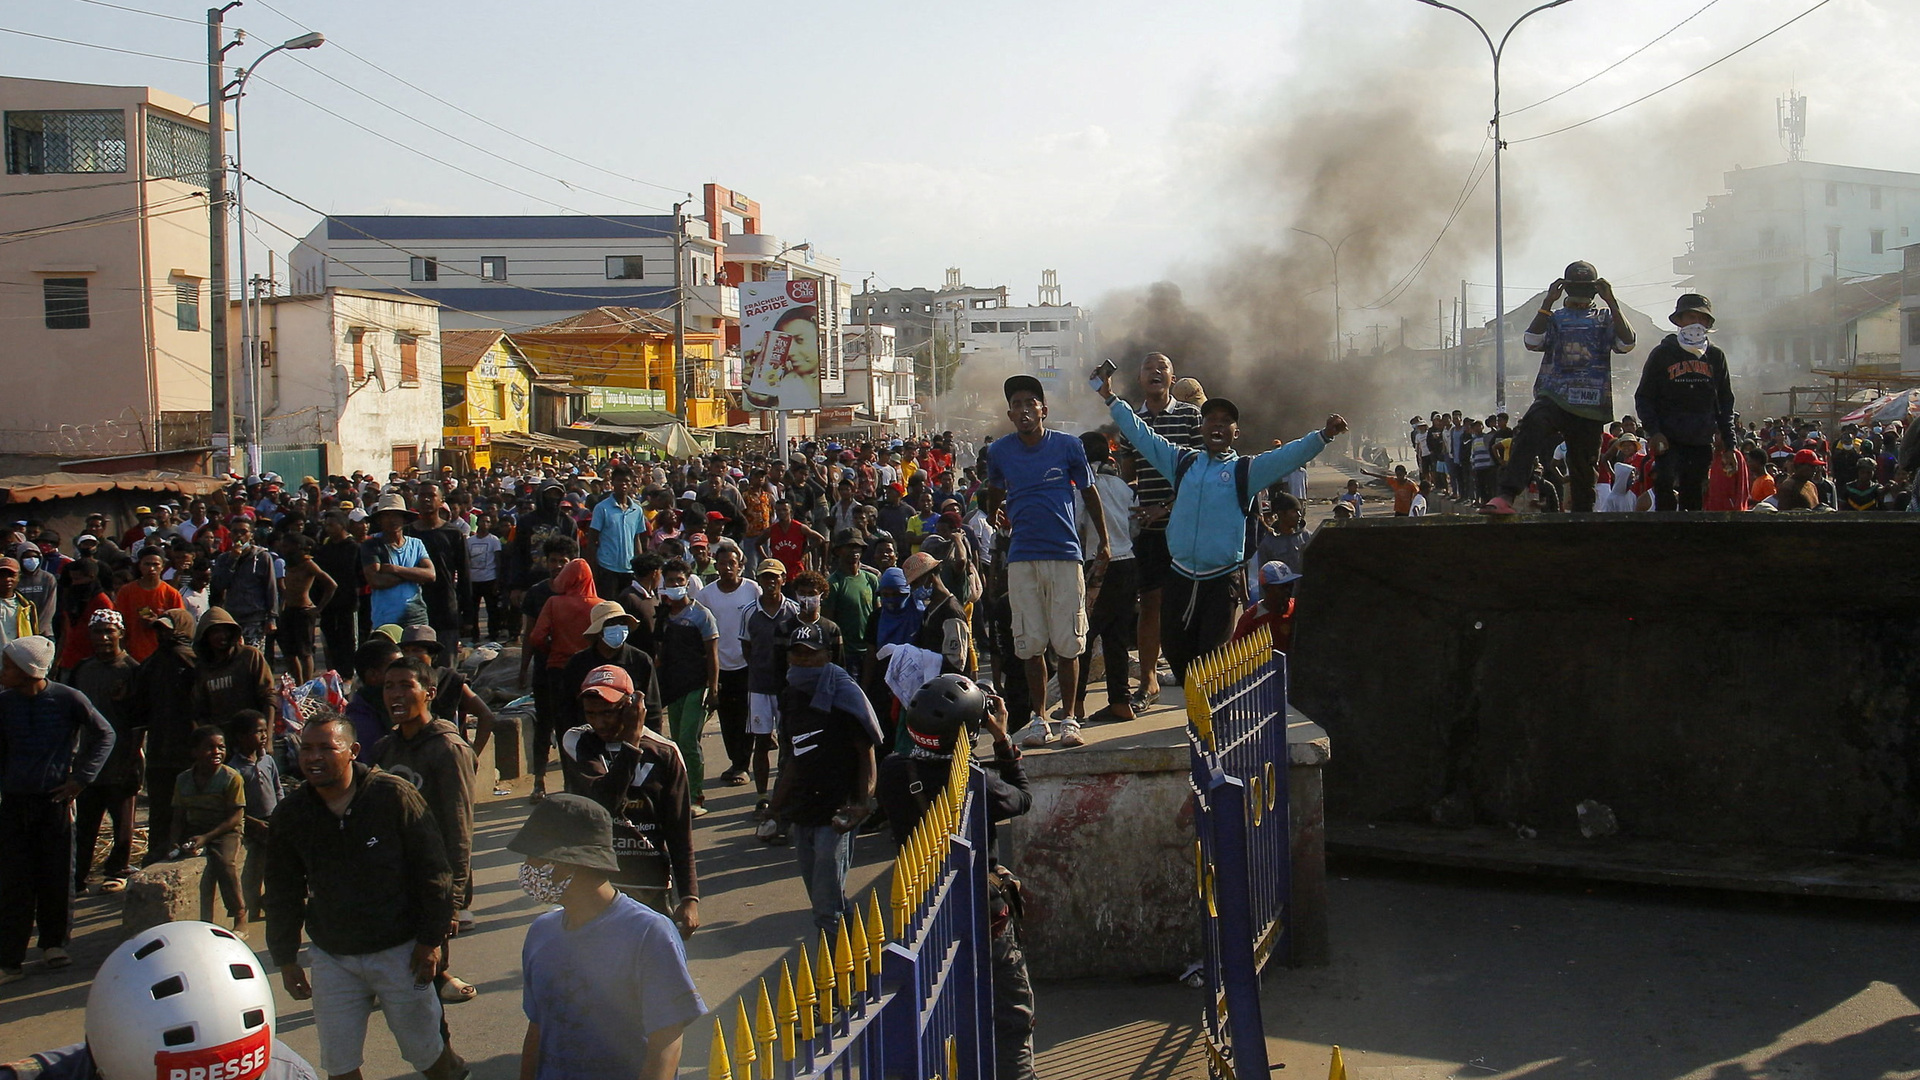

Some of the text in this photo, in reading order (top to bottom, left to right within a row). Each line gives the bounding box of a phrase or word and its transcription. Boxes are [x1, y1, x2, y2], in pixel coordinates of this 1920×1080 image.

[746, 305, 789, 322] RAPIDE
[775, 540, 797, 551] BULLS
[170, 1045, 265, 1080] PRESSE
